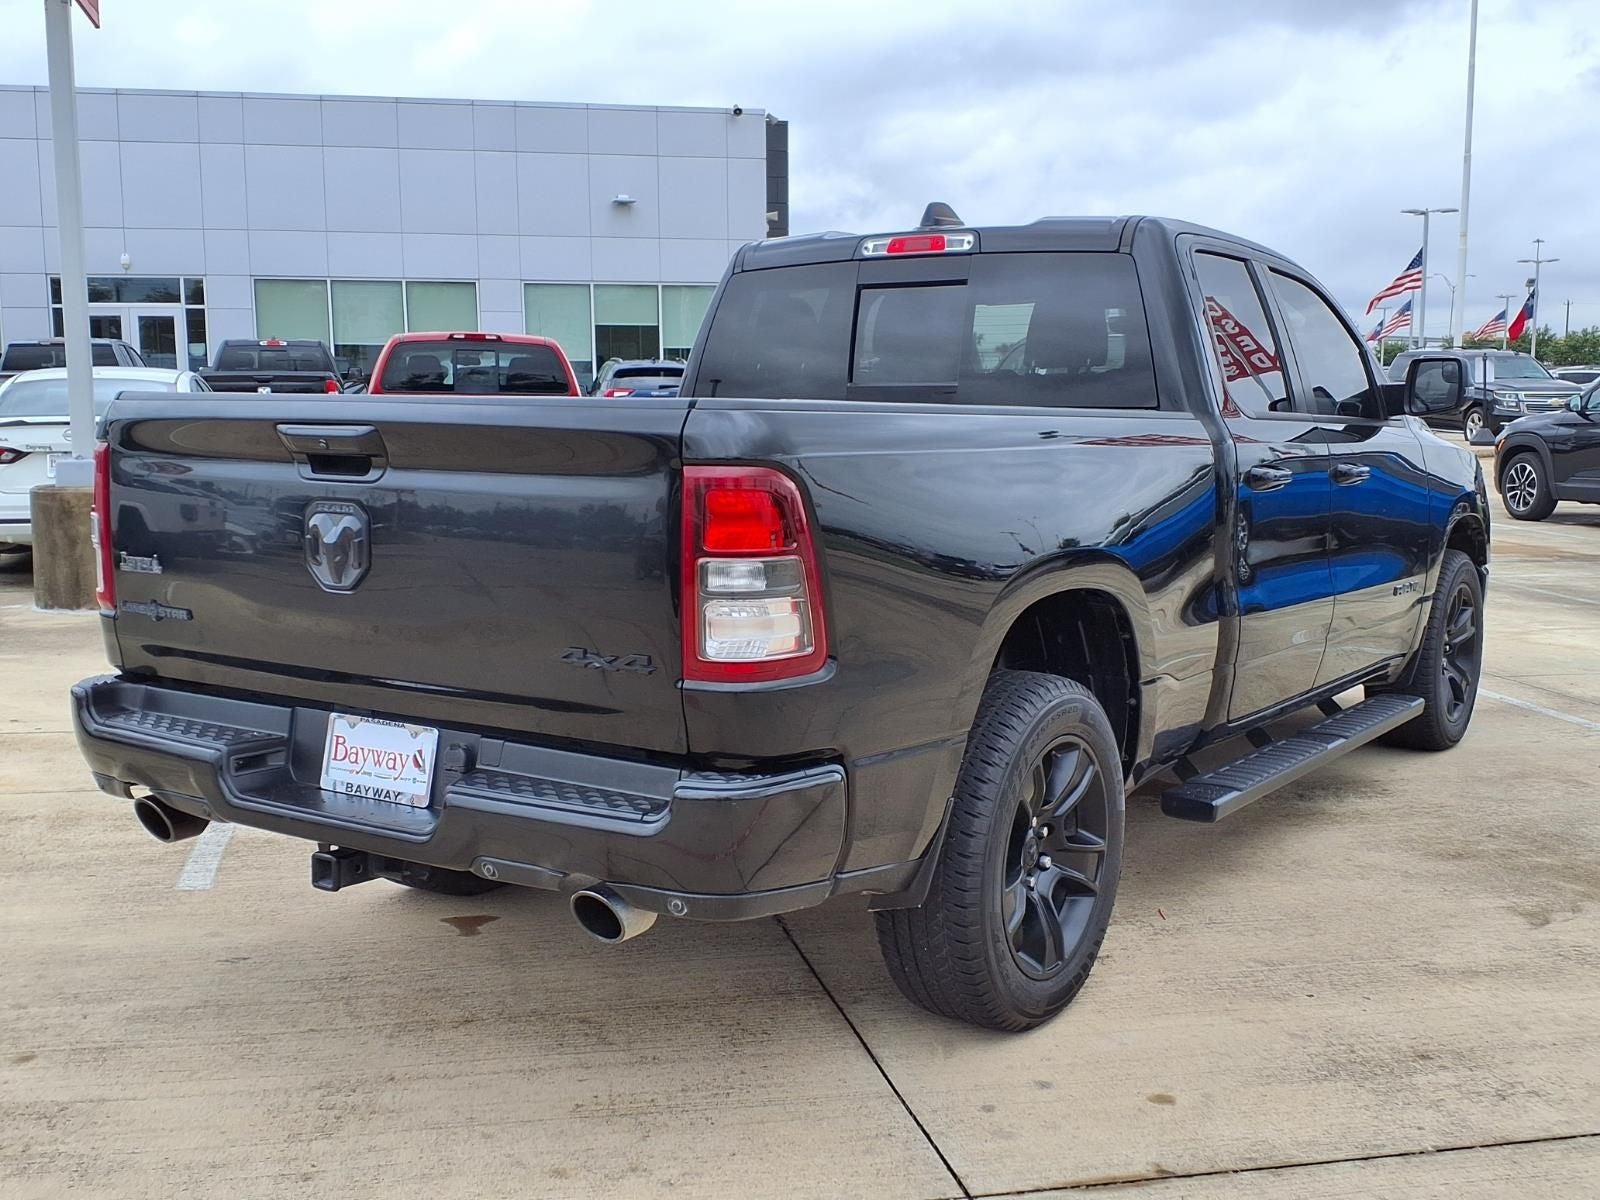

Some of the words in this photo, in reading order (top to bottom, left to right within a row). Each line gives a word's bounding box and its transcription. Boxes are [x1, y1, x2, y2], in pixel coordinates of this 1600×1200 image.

[158, 607, 188, 621] STAR
[359, 717, 406, 729] PASADENA
[332, 735, 410, 780] Bayway
[345, 782, 401, 801] BAYWAY
